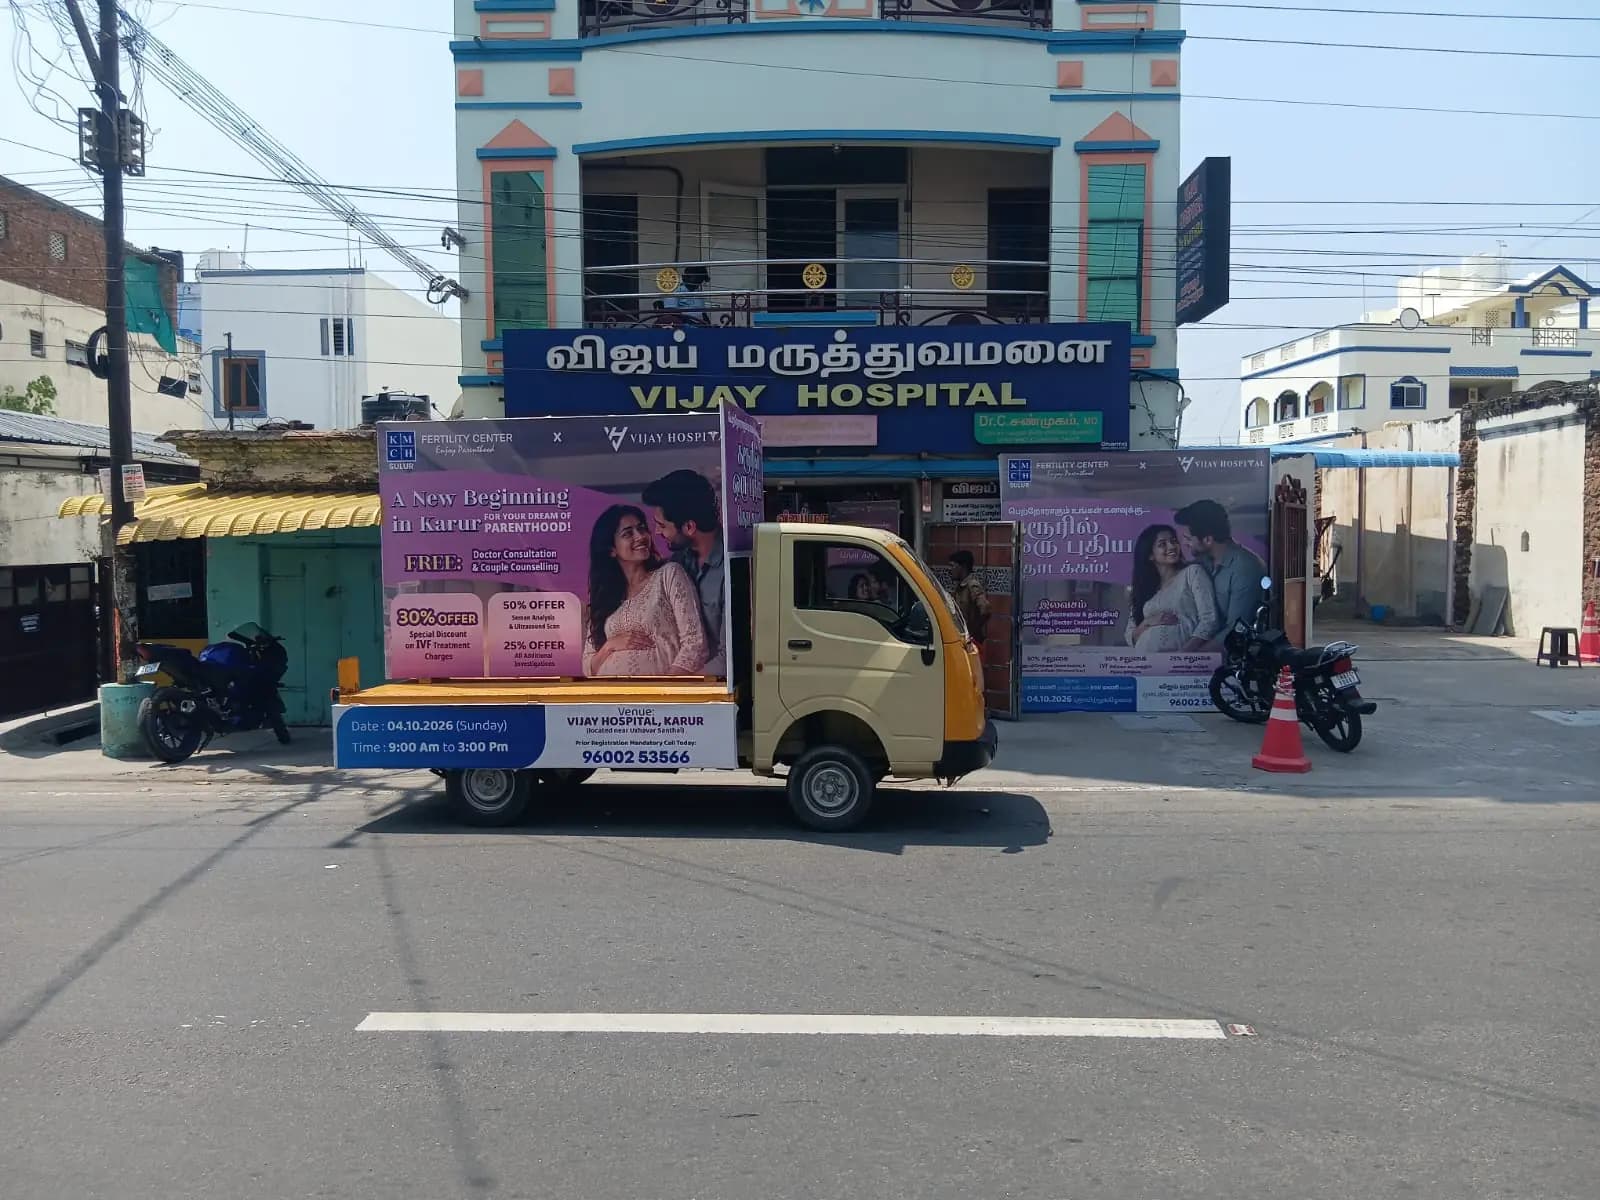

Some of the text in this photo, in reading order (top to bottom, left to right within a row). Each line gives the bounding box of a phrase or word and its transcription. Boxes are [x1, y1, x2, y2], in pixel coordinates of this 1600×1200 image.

[546, 329, 1113, 378] விஜய் மருத்துவமனை
[630, 382, 1027, 410] VIJAY HOSPITAL
[421, 434, 470, 444] FERTILITY
[473, 433, 513, 443] CENTER
[630, 432, 663, 446] VIJAY
[435, 447, 456, 456] Enjoy
[457, 445, 495, 454] Parenthood
[1076, 461, 1109, 469] CENTER
[1220, 459, 1265, 468] HOSPITAL
[951, 482, 998, 494] விஜய்
[392, 488, 570, 510] A New Beginning
[528, 512, 558, 520] DREAM
[560, 512, 572, 520] OF
[392, 515, 483, 533] in Karur
[484, 522, 572, 534] PARENTHOOD!
[473, 550, 558, 559] Doctor Consultation
[405, 554, 462, 572] FREE:
[472, 562, 560, 574] & Couple Counselling
[503, 600, 565, 610] 50% OFFER
[398, 610, 478, 626] 30% OFFER
[532, 614, 555, 622] Analysis
[409, 630, 467, 639] Special Discount
[416, 640, 432, 649] IVF
[433, 641, 470, 649] Treatment
[504, 641, 565, 650] 25% OFFER
[425, 653, 453, 661] Charges
[1169, 698, 1200, 706] 96002
[618, 707, 655, 716] Venue:
[352, 721, 379, 731] Date
[387, 720, 454, 731] 04.10.2026
[456, 719, 507, 732] (Sunday)
[567, 716, 704, 727] VIJAY HOSPITAL, KARUR
[352, 742, 381, 752] Time
[388, 742, 417, 752] 9:00
[419, 742, 440, 752] Am
[443, 743, 455, 752] to
[458, 741, 486, 752] 3:00
[489, 741, 509, 752] Pm
[582, 750, 690, 764] 96002 53566
